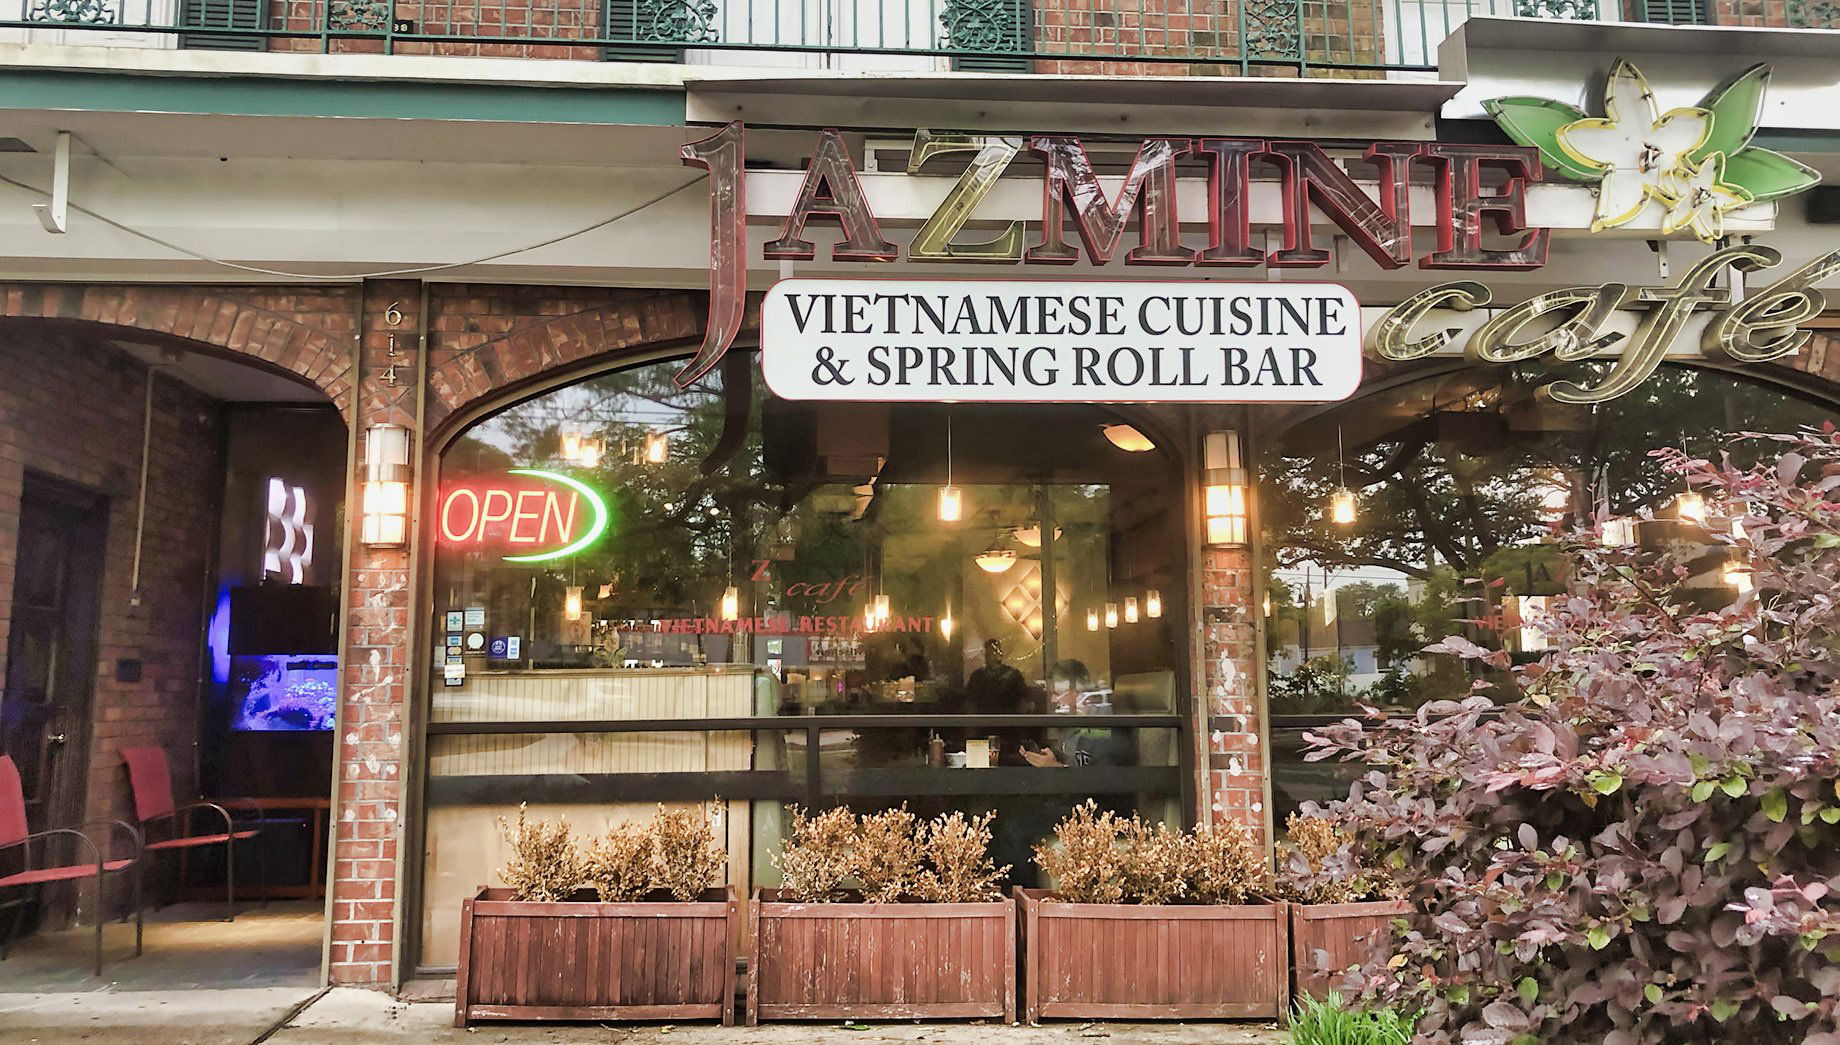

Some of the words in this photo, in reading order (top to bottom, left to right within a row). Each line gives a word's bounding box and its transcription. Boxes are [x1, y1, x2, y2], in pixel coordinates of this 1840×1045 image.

[673, 119, 1549, 389] JAZMINE
[785, 294, 1125, 336] VIETNAMESE
[1138, 296, 1347, 337] CUISINE
[1366, 243, 1840, 403] café
[811, 347, 853, 387] &
[867, 346, 1059, 388] SPRING
[1072, 346, 1210, 387] ROLL
[1221, 347, 1323, 387] BAR
[441, 488, 578, 543] OPEN
